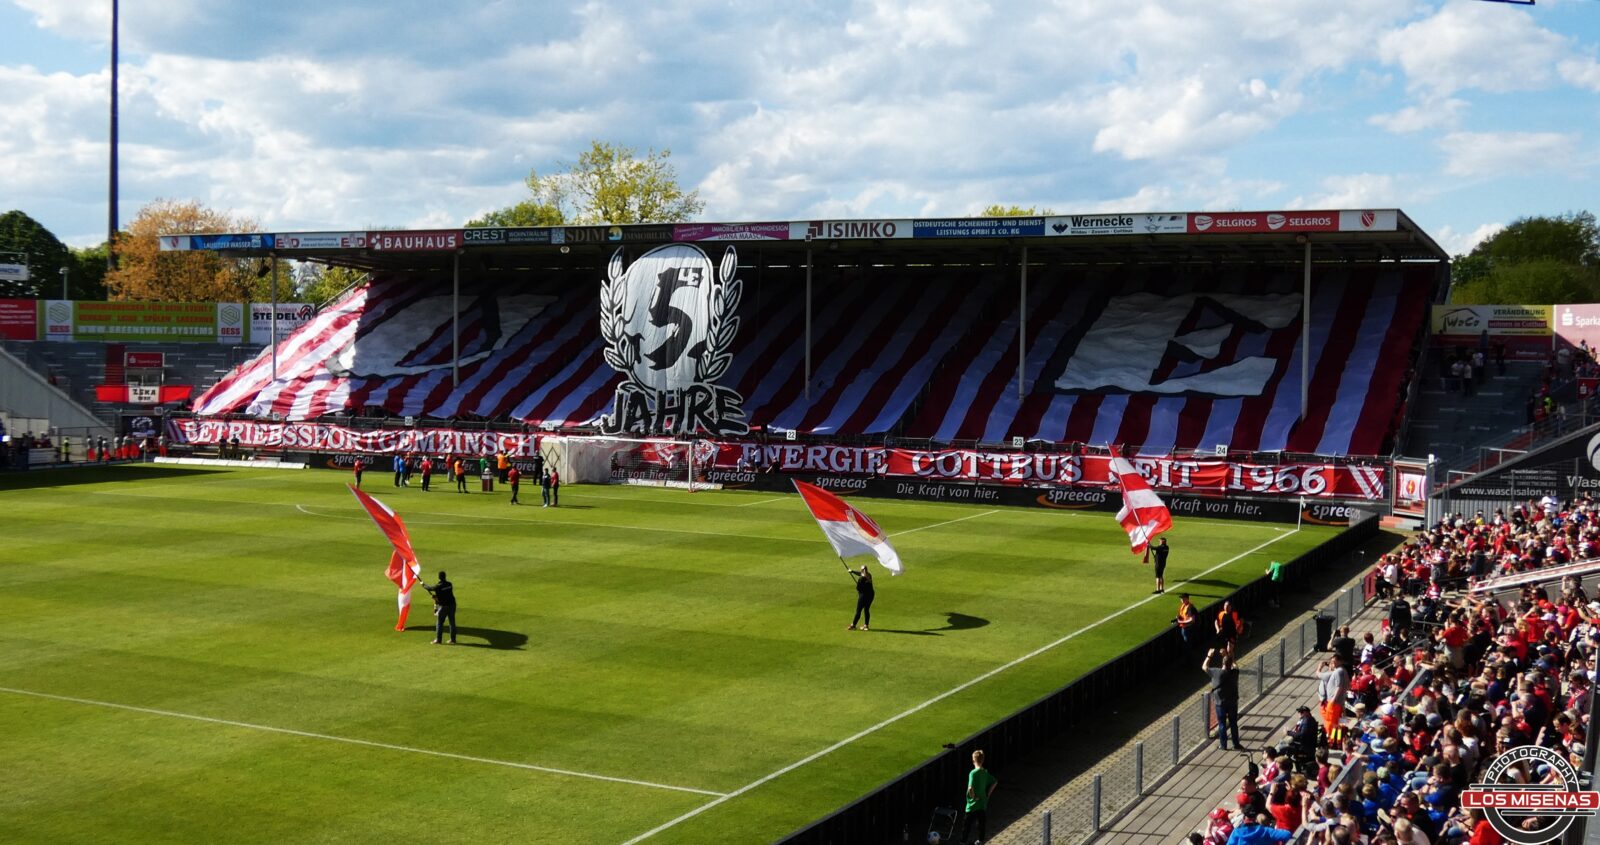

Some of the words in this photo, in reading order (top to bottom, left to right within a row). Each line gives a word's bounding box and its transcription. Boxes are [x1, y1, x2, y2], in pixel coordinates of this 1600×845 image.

[1003, 219, 1017, 227] UND
[1071, 215, 1133, 228] Wernecke
[1216, 218, 1257, 228] SELGROS
[1289, 217, 1331, 226] SELGROS
[463, 228, 506, 240] CREST
[827, 222, 897, 238] ISIMKO
[384, 235, 457, 249] BAUHAUS
[253, 312, 298, 321] STEDEL
[600, 382, 751, 437] JAHRE
[786, 430, 796, 440] 22
[1014, 438, 1023, 446] 23
[1216, 446, 1226, 455] 24
[742, 443, 889, 475] ENERGIE
[911, 450, 1082, 483] COTTBUS
[1227, 462, 1326, 494] 1966
[896, 482, 915, 495] Die
[918, 484, 947, 498] Kraft
[949, 488, 970, 498] von
[973, 487, 1000, 500] hier.
[1171, 497, 1202, 514] Kraft
[1205, 502, 1229, 513] von
[1233, 501, 1263, 515] hier.
